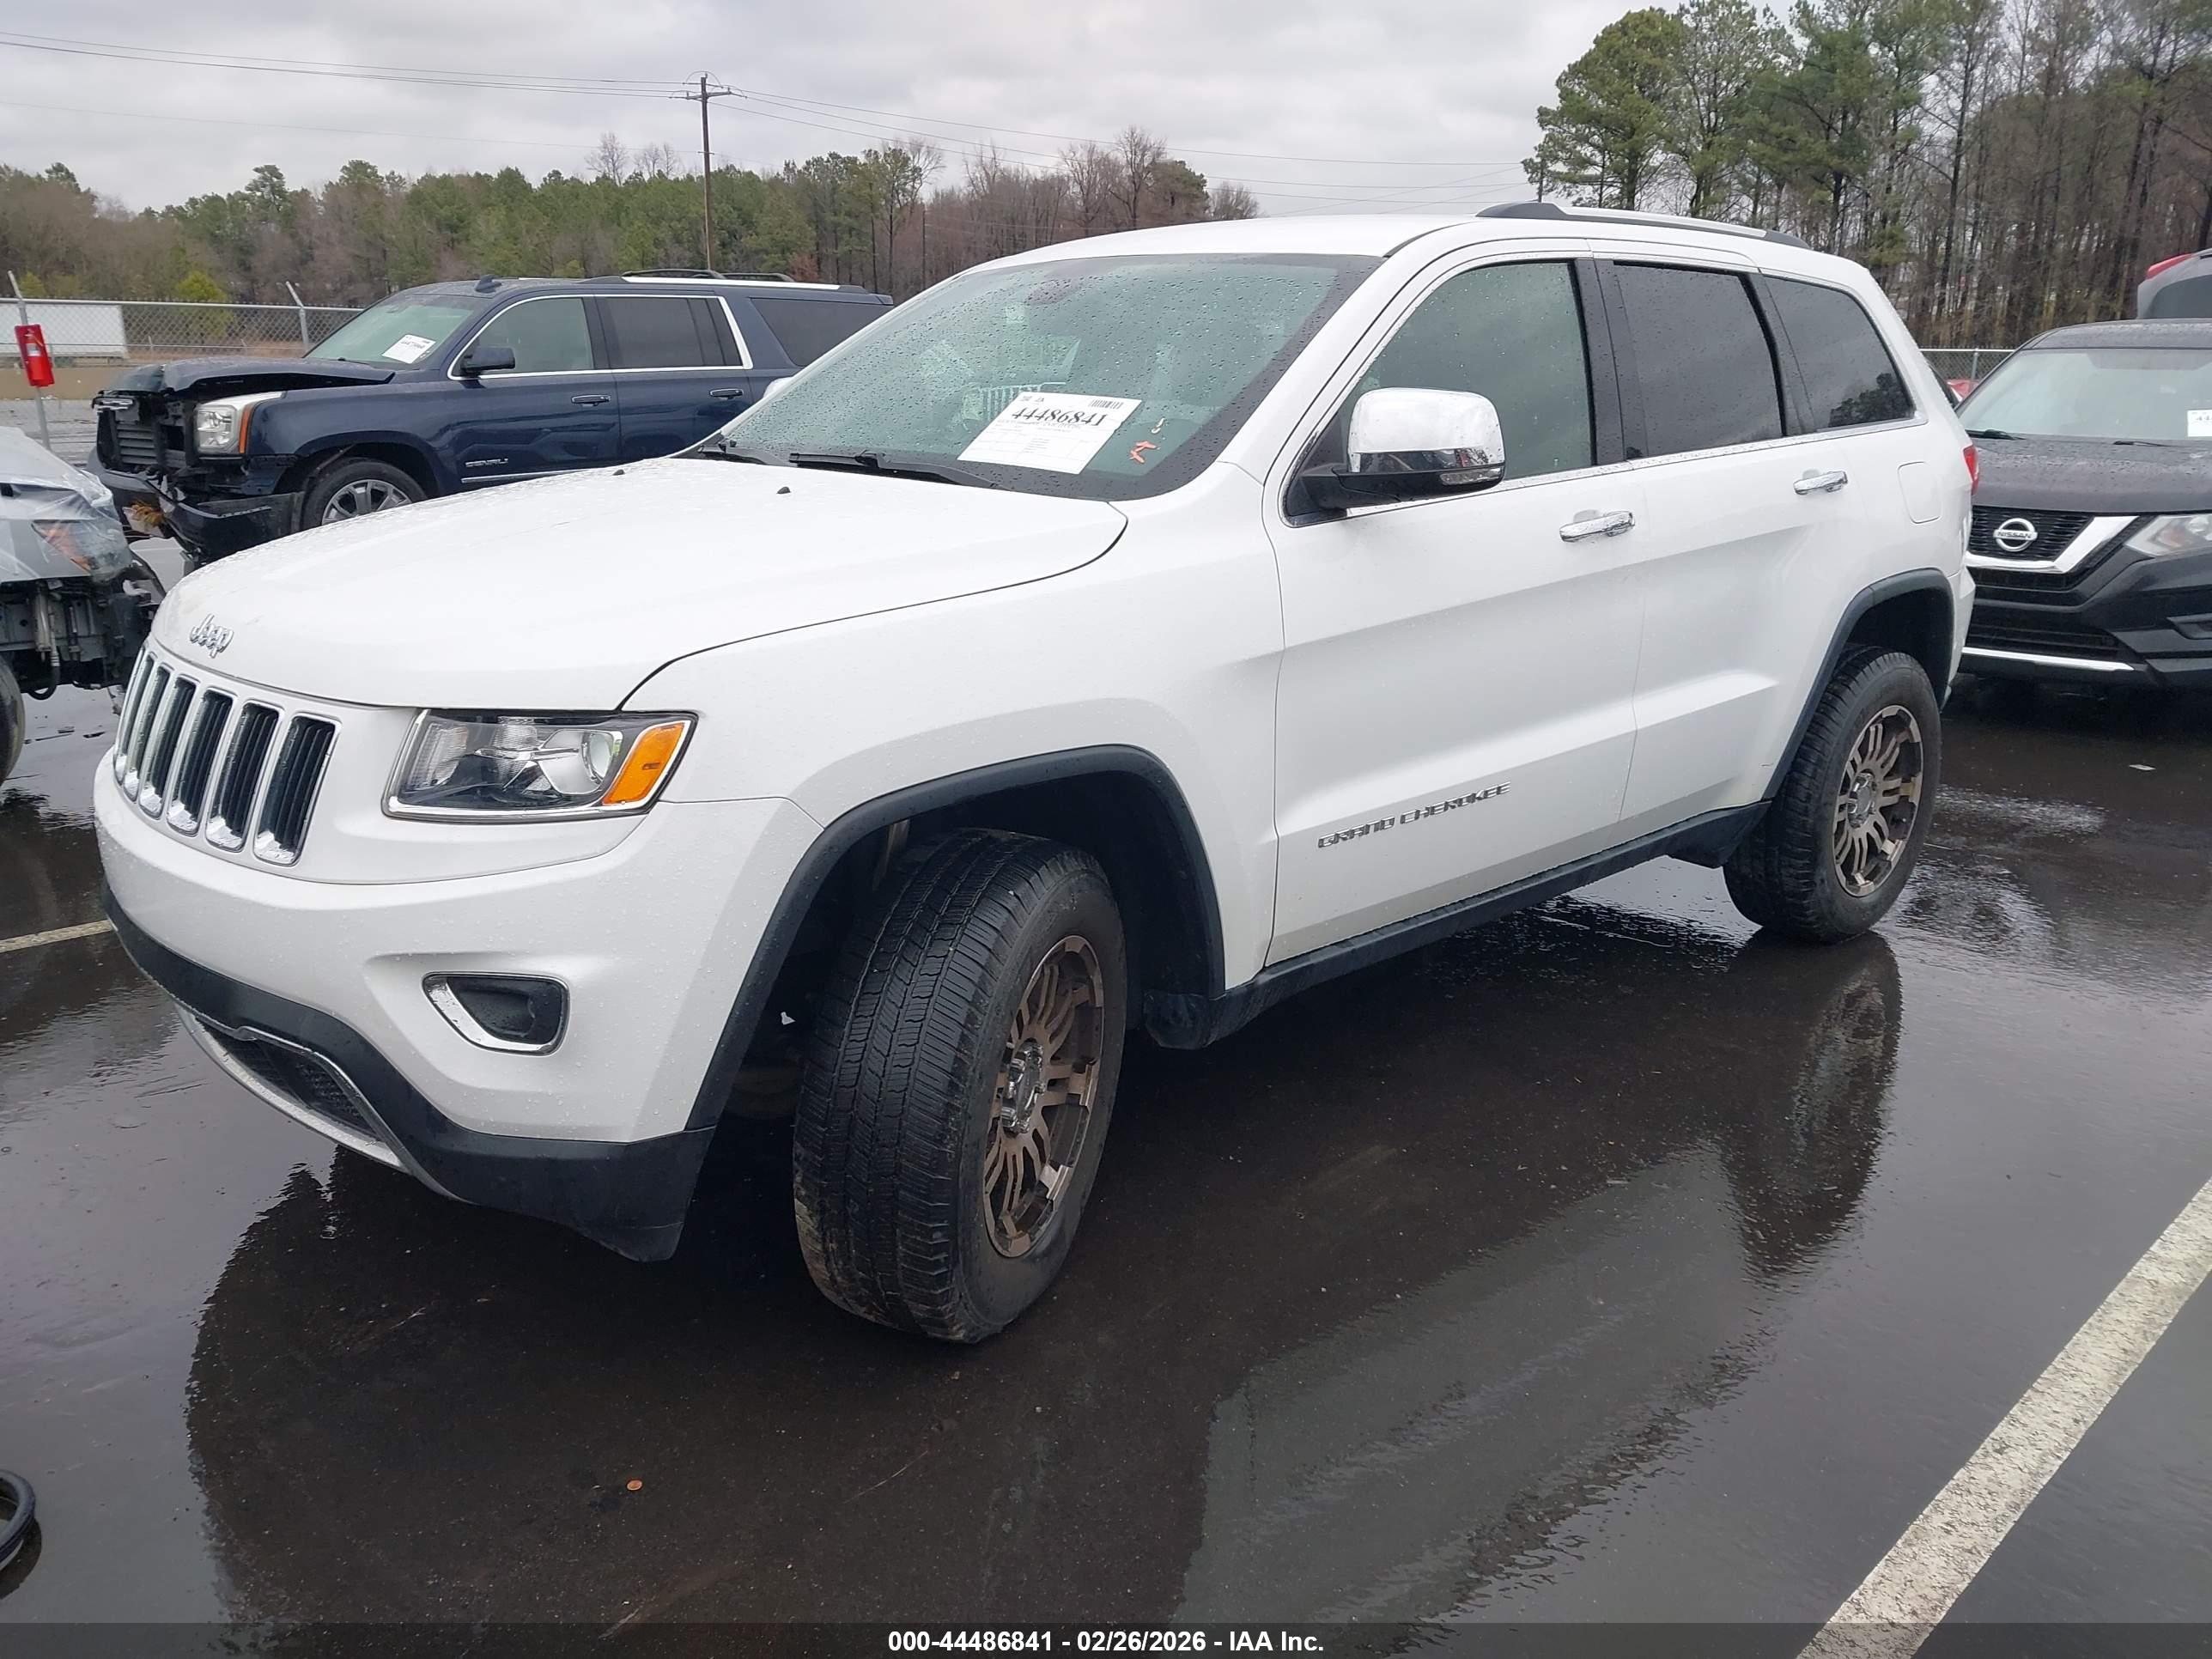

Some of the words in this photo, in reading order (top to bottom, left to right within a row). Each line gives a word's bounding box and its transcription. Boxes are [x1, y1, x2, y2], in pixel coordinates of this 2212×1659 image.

[1012, 407, 1108, 426] 44486841
[190, 613, 234, 659] Jeep
[1317, 816, 1395, 848] GRAND
[1399, 781, 1511, 825] CHEROKEE
